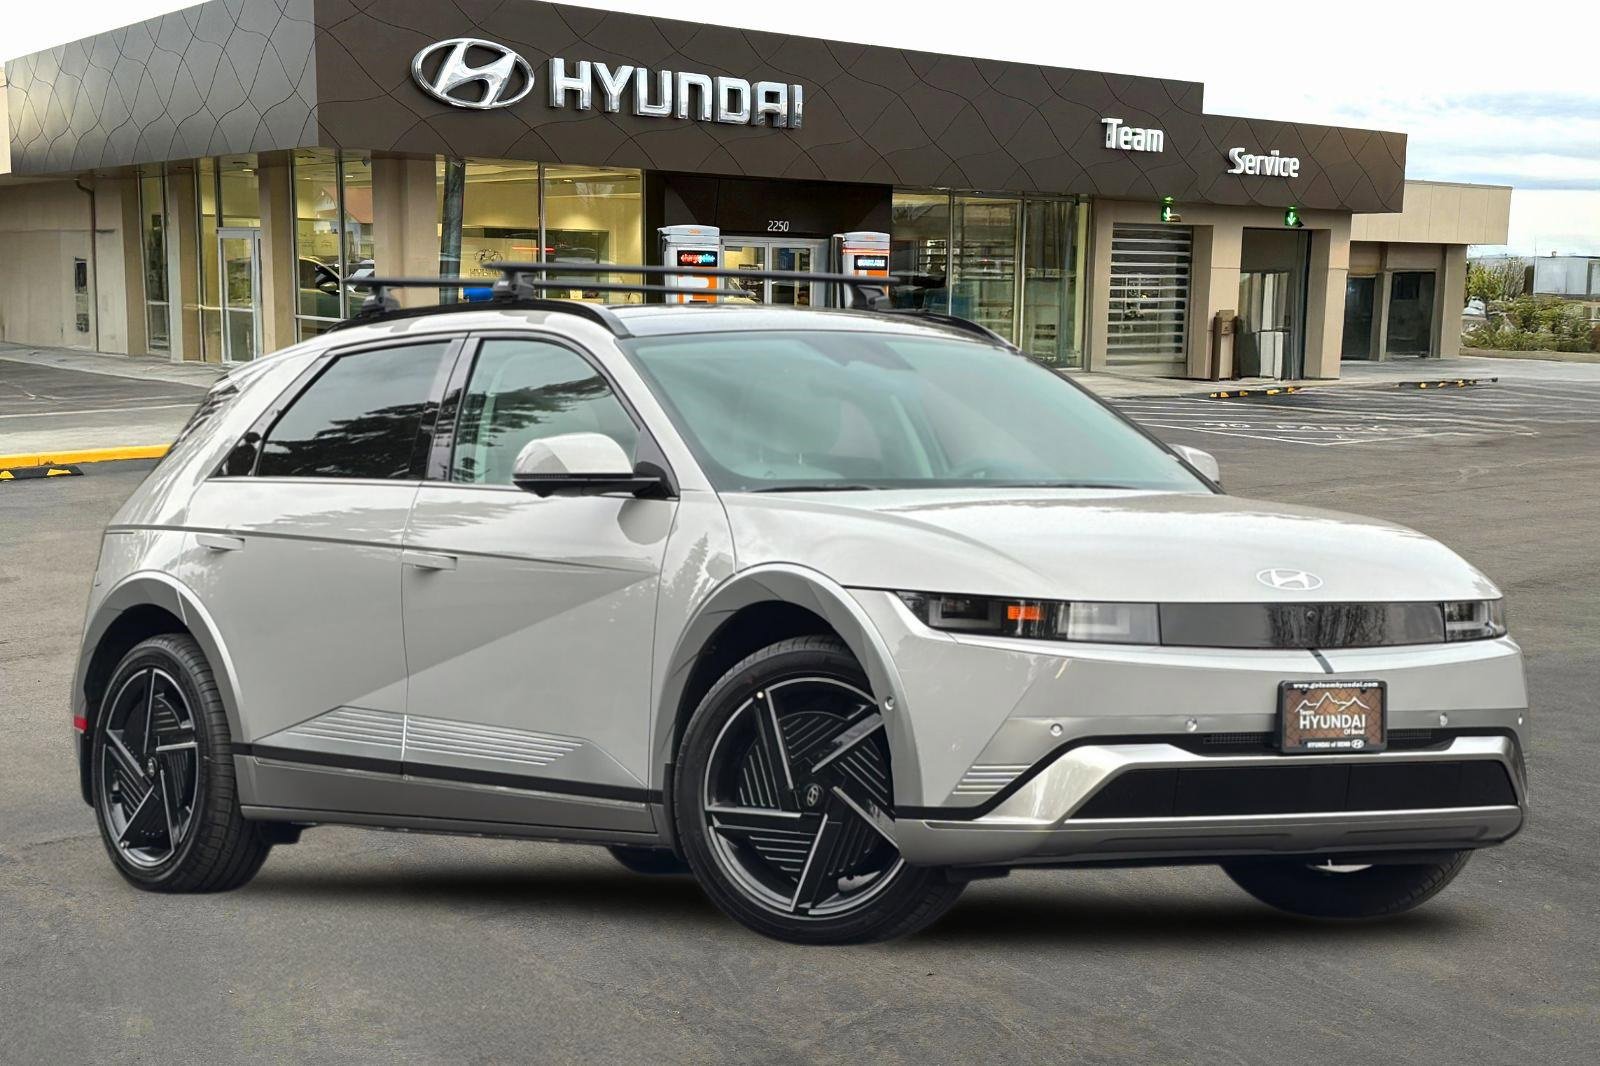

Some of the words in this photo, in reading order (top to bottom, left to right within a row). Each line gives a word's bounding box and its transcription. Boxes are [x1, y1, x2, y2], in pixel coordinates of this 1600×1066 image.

[548, 57, 803, 129] HYUNDAI
[1101, 117, 1164, 153] Team
[1227, 147, 1300, 178] Service
[767, 220, 790, 232] 2250
[1299, 714, 1366, 730] HYUNDAI
